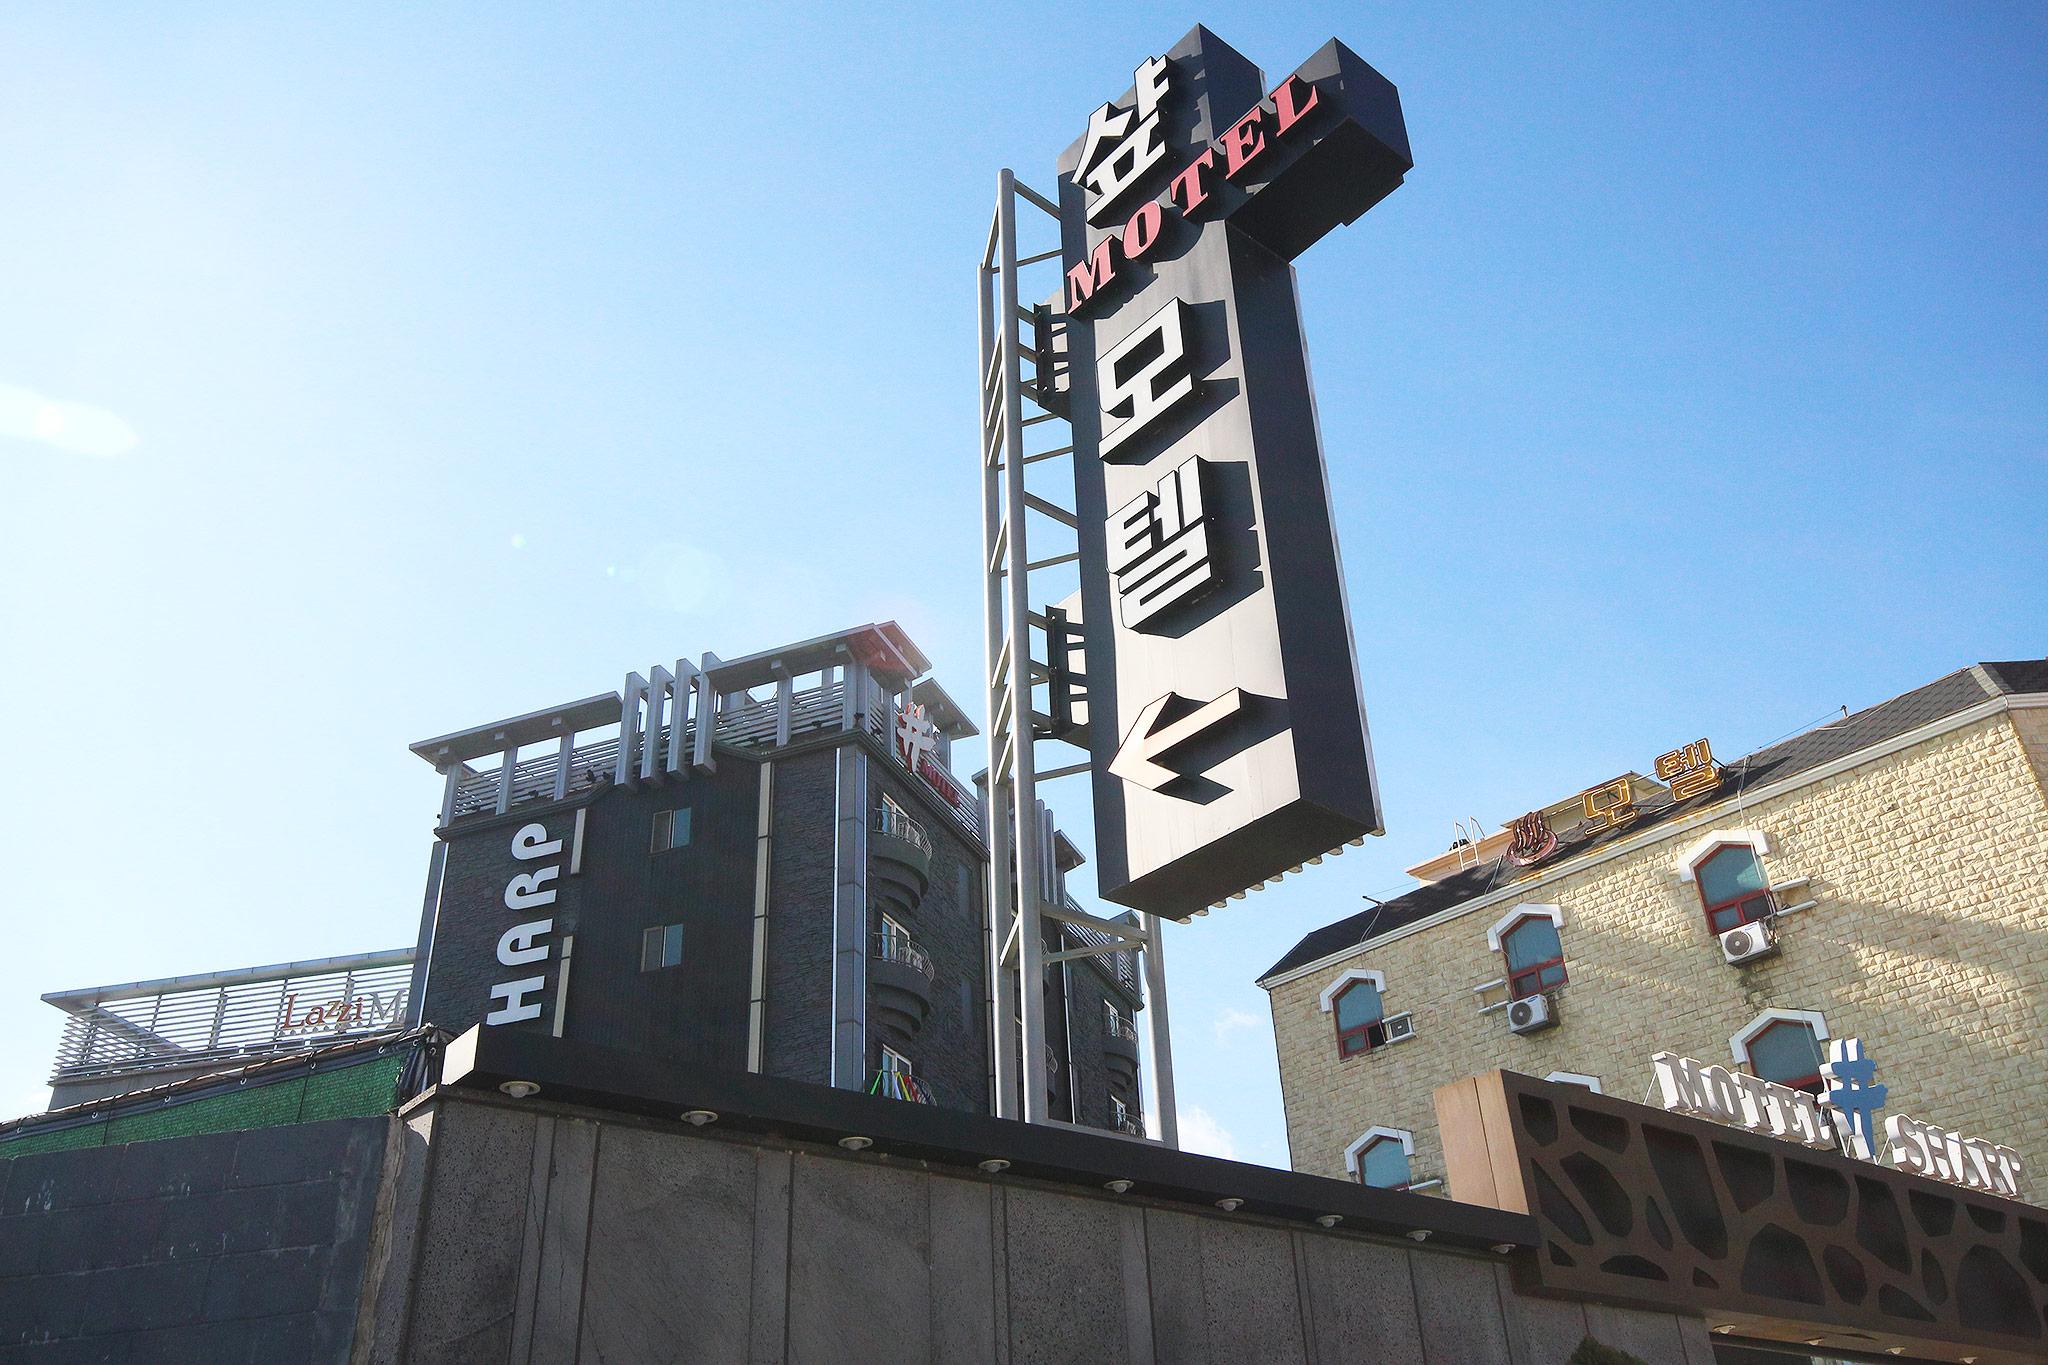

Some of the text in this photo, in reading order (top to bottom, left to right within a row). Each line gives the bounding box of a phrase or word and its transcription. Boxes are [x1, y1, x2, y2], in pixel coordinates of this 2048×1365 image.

[1067, 74, 1319, 314] MOTEL
[1097, 297, 1212, 631] 모텔
[1582, 737, 1722, 836] 모텔
[1652, 1051, 1837, 1151] MOTEL
[1885, 1114, 2024, 1200] SHARP
